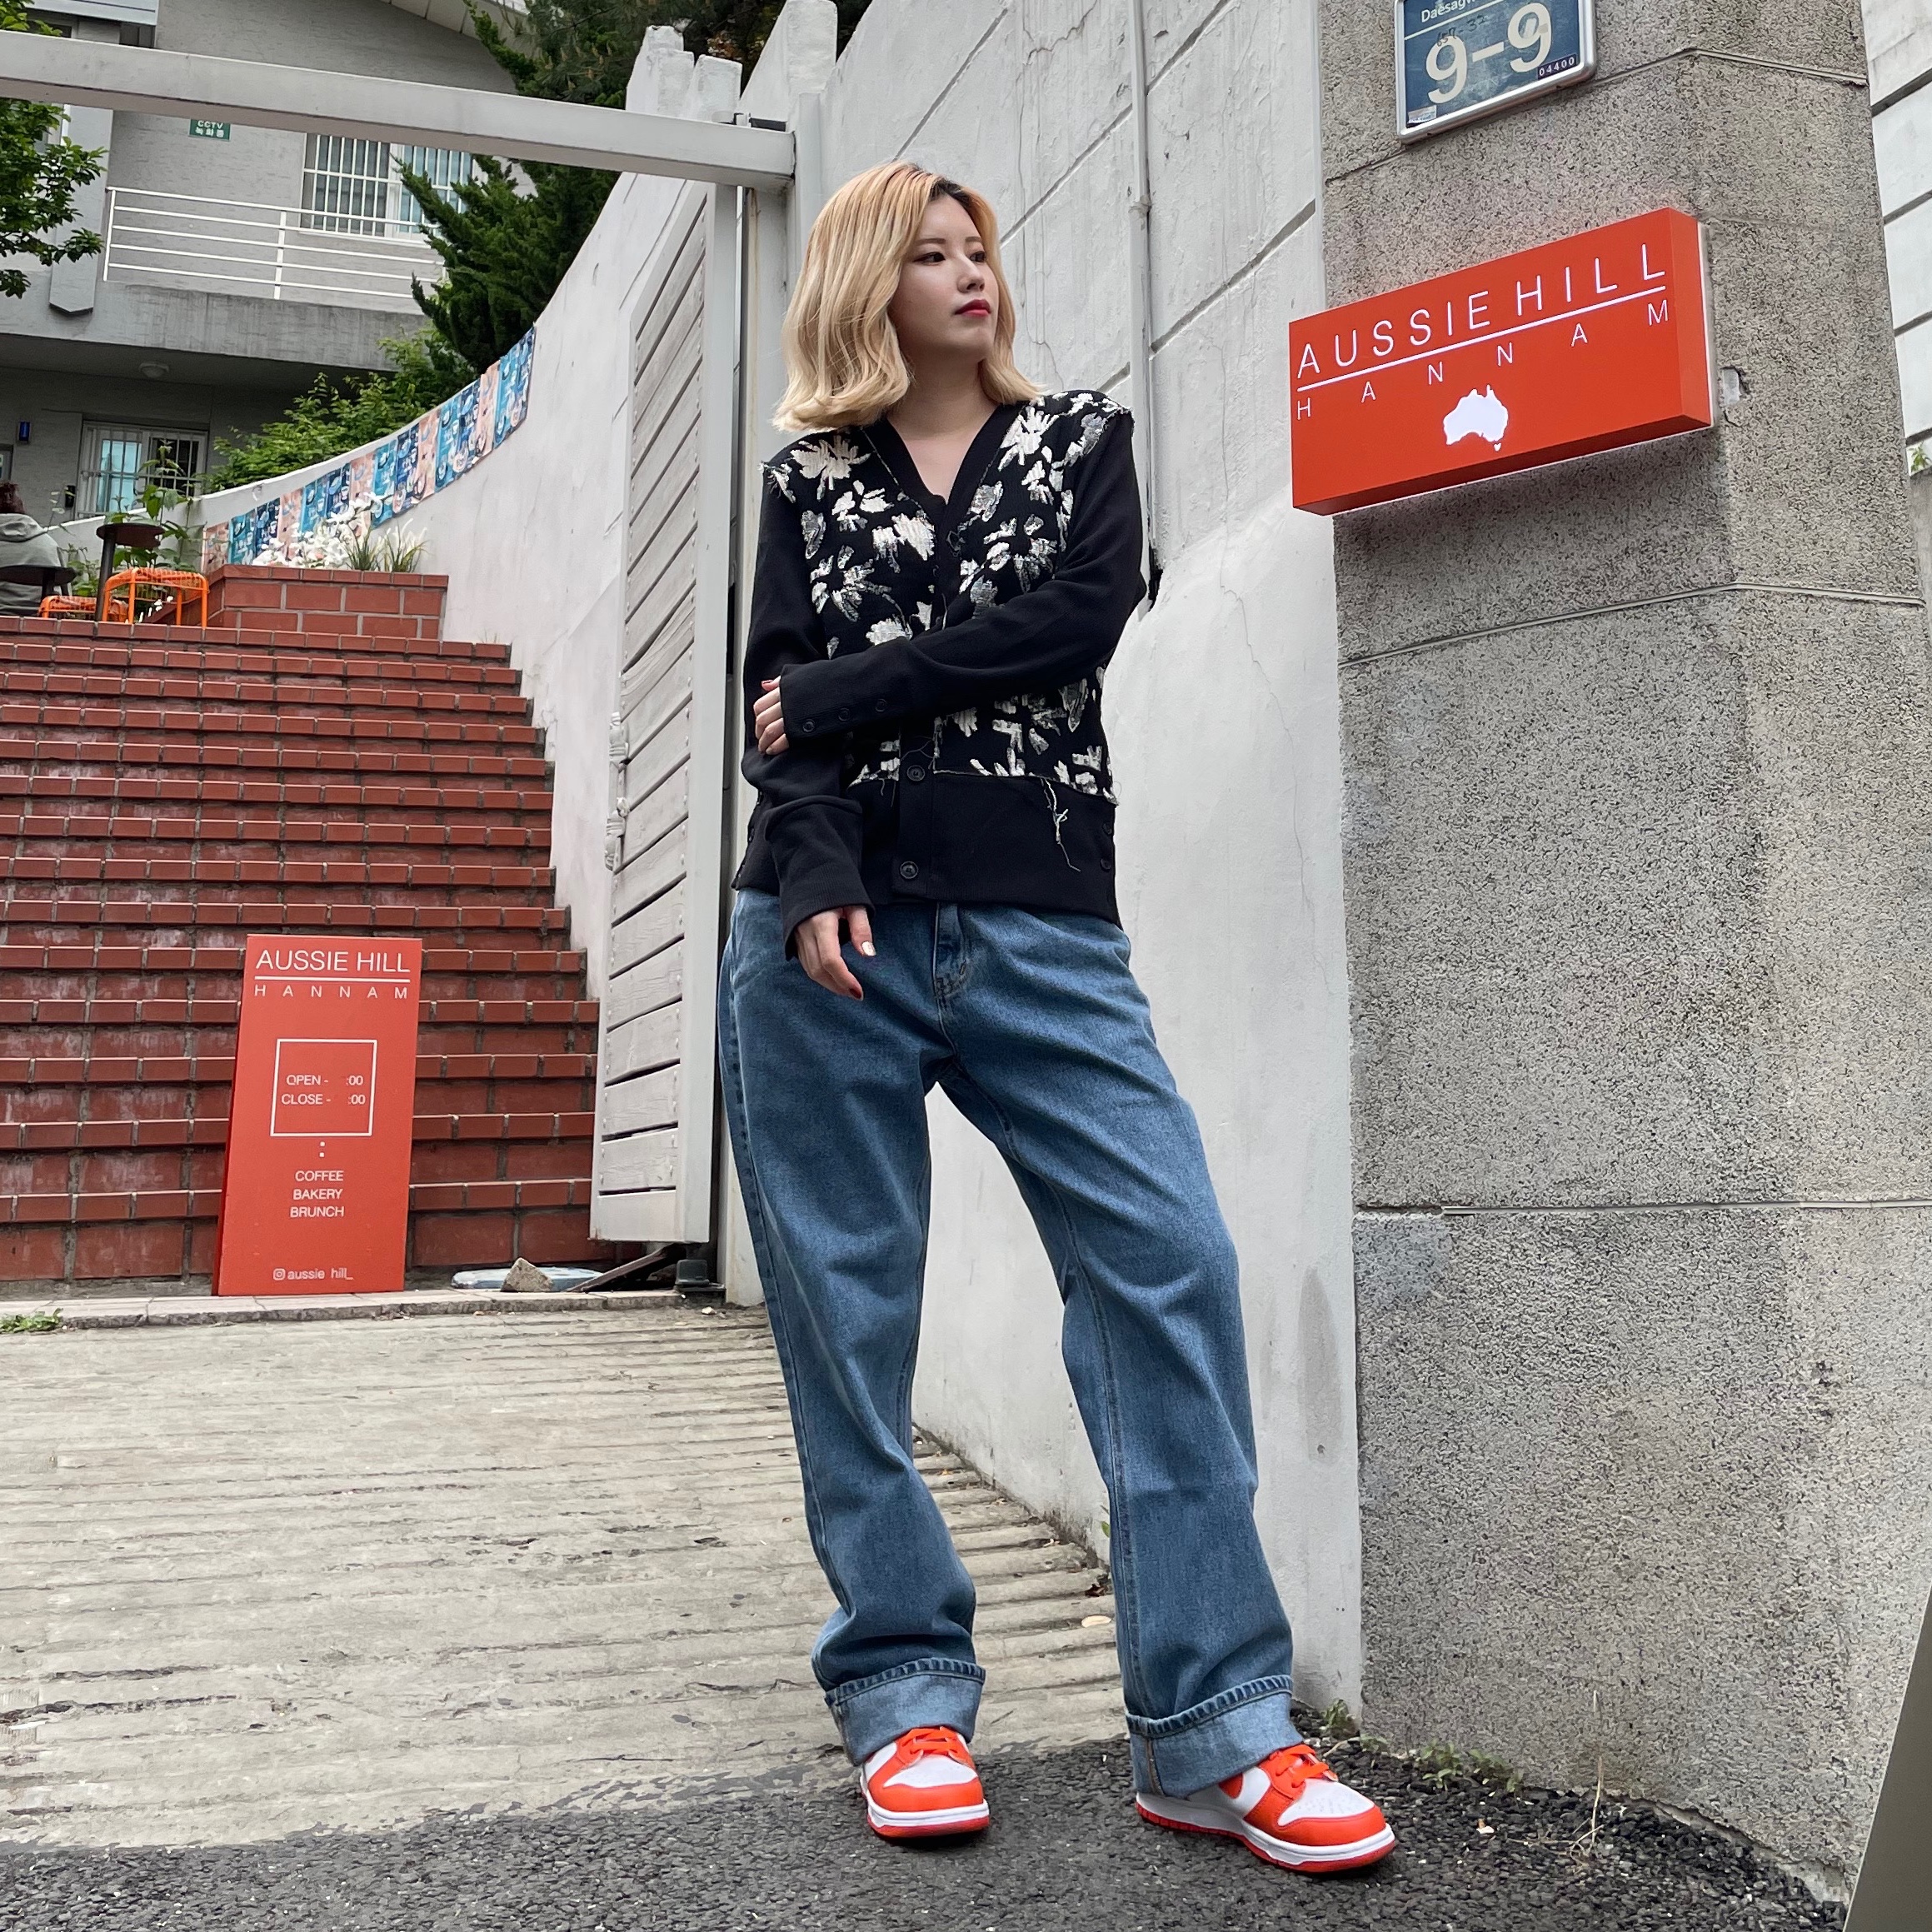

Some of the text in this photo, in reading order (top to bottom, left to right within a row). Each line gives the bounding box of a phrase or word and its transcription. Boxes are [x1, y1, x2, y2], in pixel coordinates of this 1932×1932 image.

[1425, 2, 1553, 104] 9-9
[1538, 56, 1576, 77] 04400
[197, 120, 223, 129] CCTV
[1296, 243, 1665, 380] AUSSIE HILL
[1295, 298, 1670, 422] HANNAM
[255, 949, 411, 973] AUSSIE HILL
[254, 984, 407, 1000] HANNAM
[295, 1170, 344, 1182] COFFEE
[292, 1188, 343, 1201] BAKERY
[290, 1206, 345, 1218] BRUNCH
